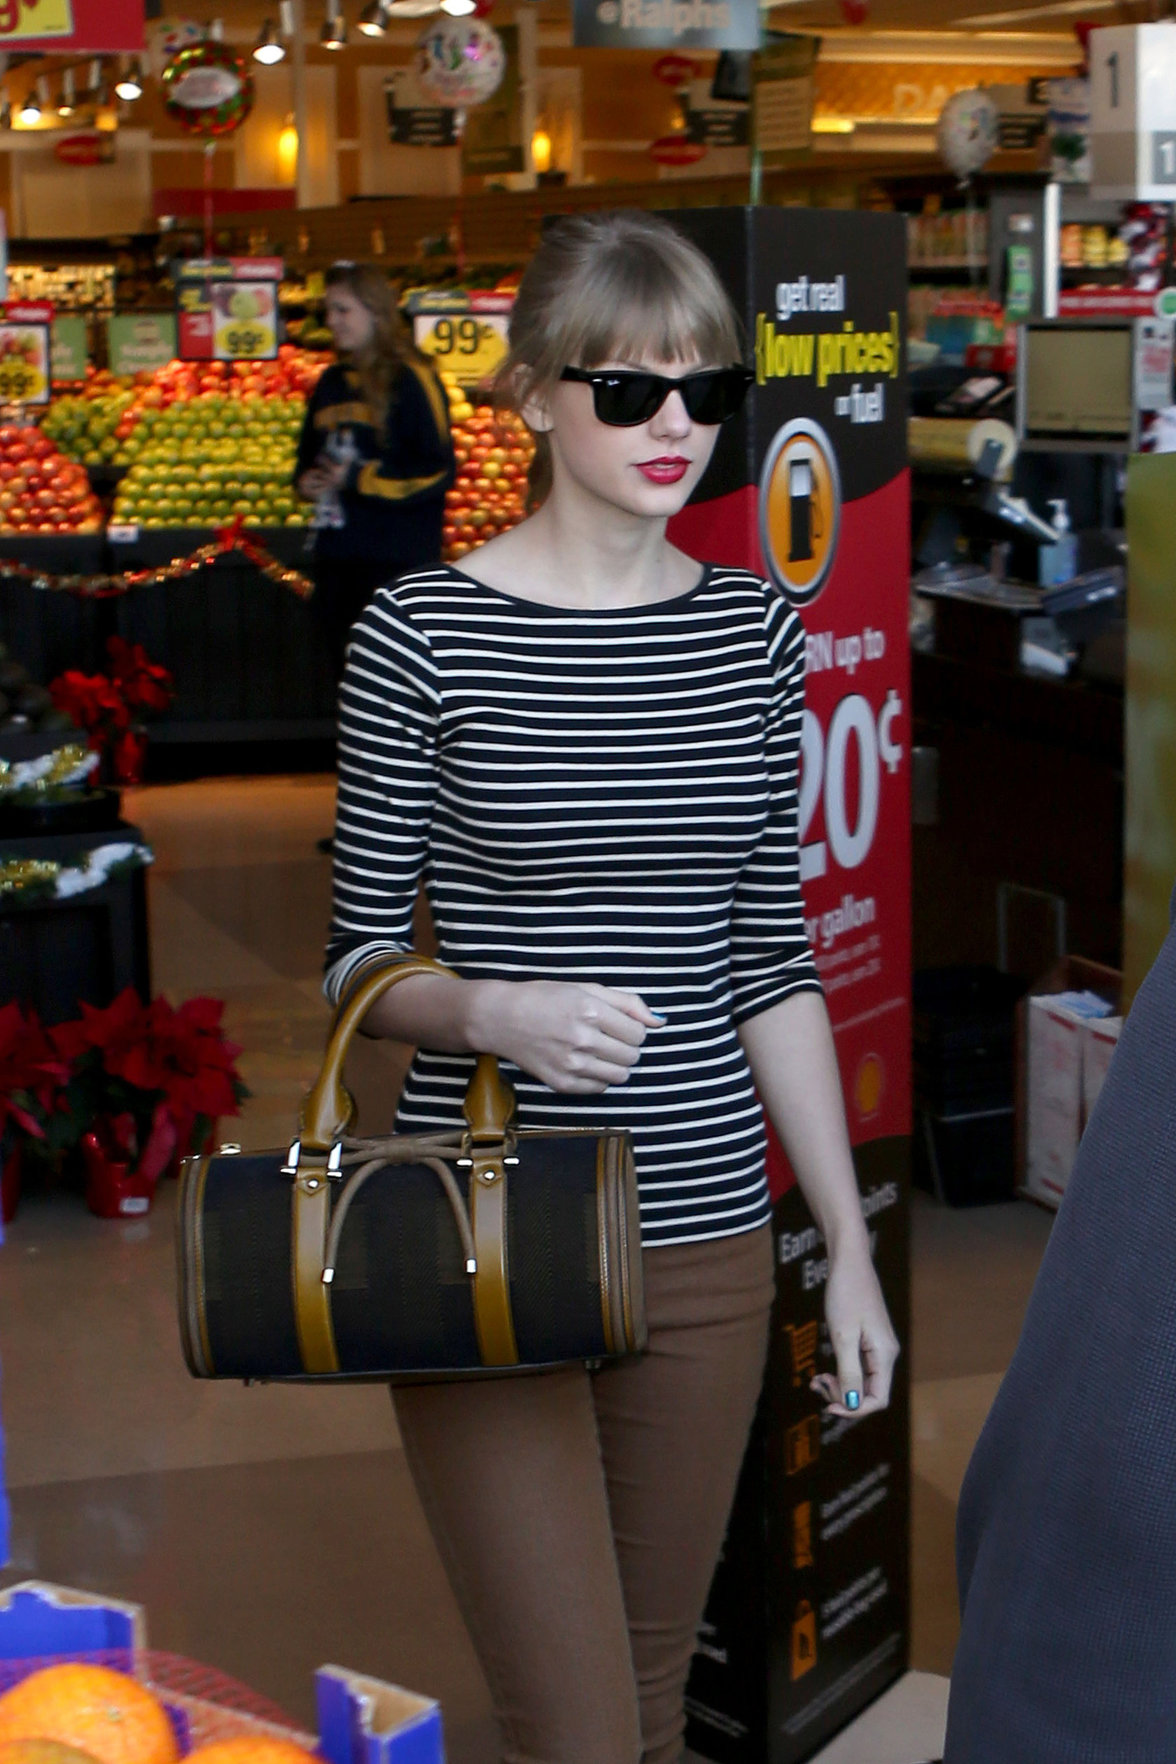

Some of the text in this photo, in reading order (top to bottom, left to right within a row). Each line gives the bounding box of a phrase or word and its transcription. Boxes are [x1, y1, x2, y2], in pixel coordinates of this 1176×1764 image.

[620, 0, 731, 36] Ralphs
[1107, 51, 1119, 108] 1
[776, 274, 845, 321] get real
[851, 382, 884, 424] fuel
[805, 627, 885, 675] RN up to
[820, 894, 876, 948] gallon
[861, 1181, 898, 1218] oints
[779, 1226, 817, 1265] Earn
